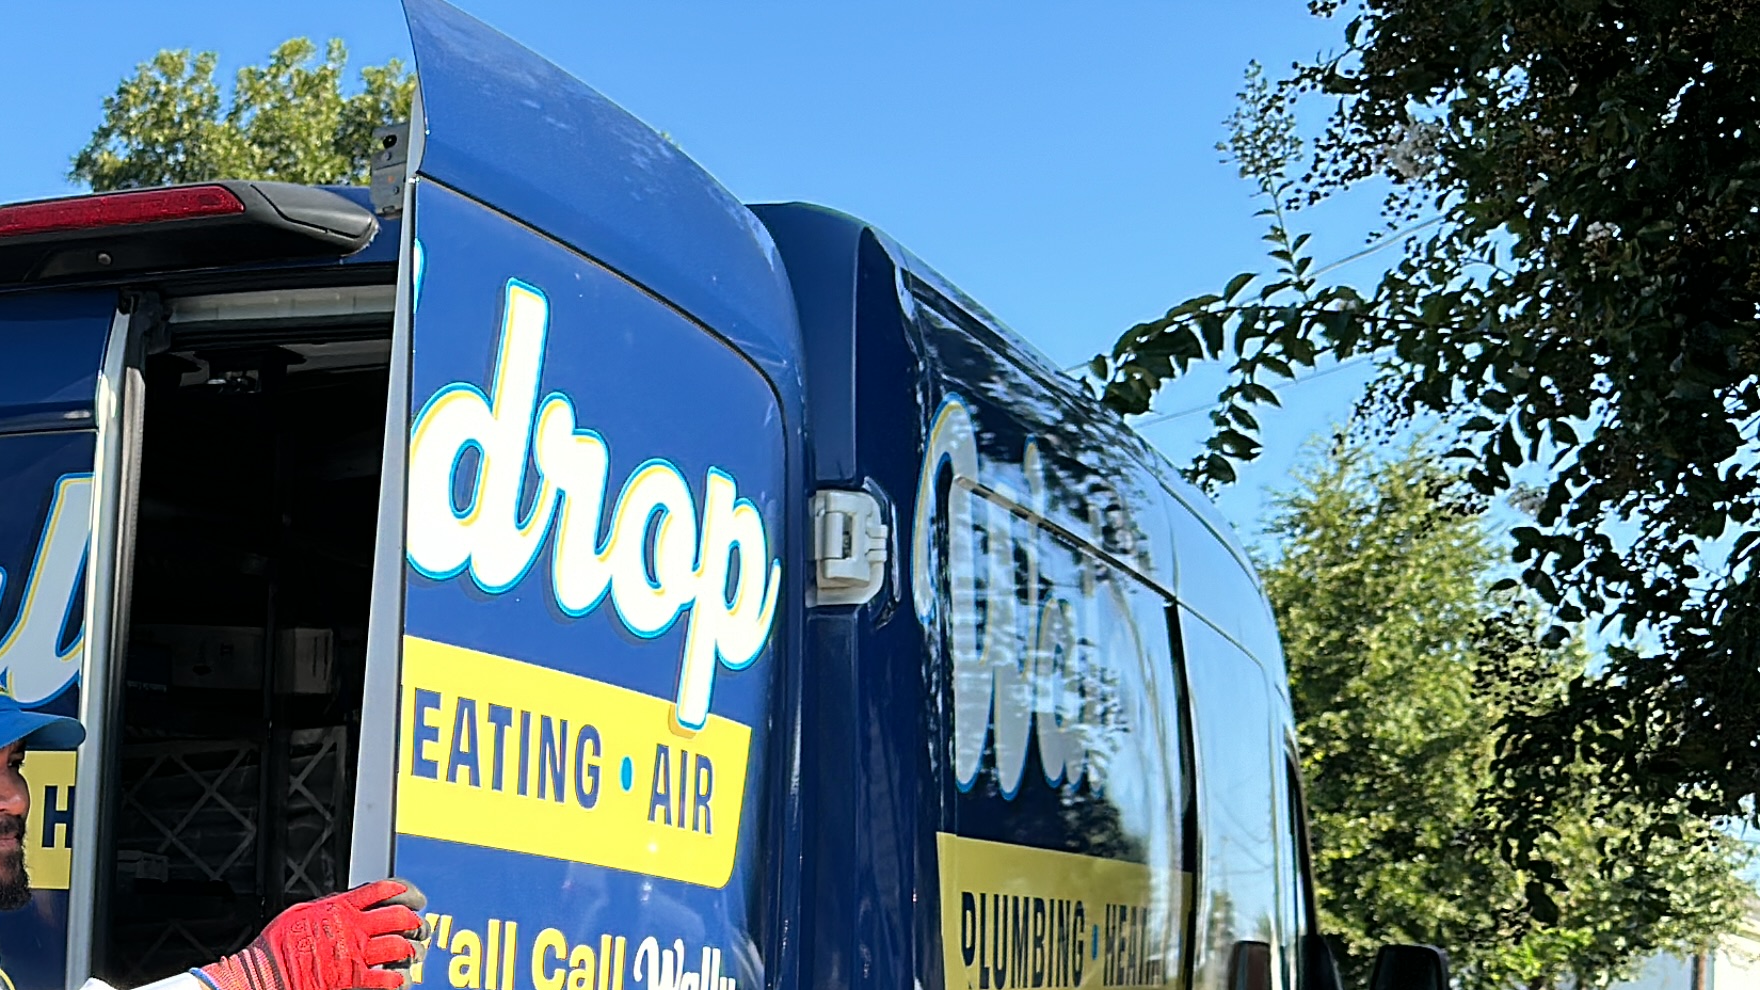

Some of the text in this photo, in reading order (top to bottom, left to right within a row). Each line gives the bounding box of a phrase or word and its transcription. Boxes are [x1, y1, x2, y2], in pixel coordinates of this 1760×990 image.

[411, 687, 714, 835] EATING AIR
[961, 891, 1085, 990] PLUMBING
